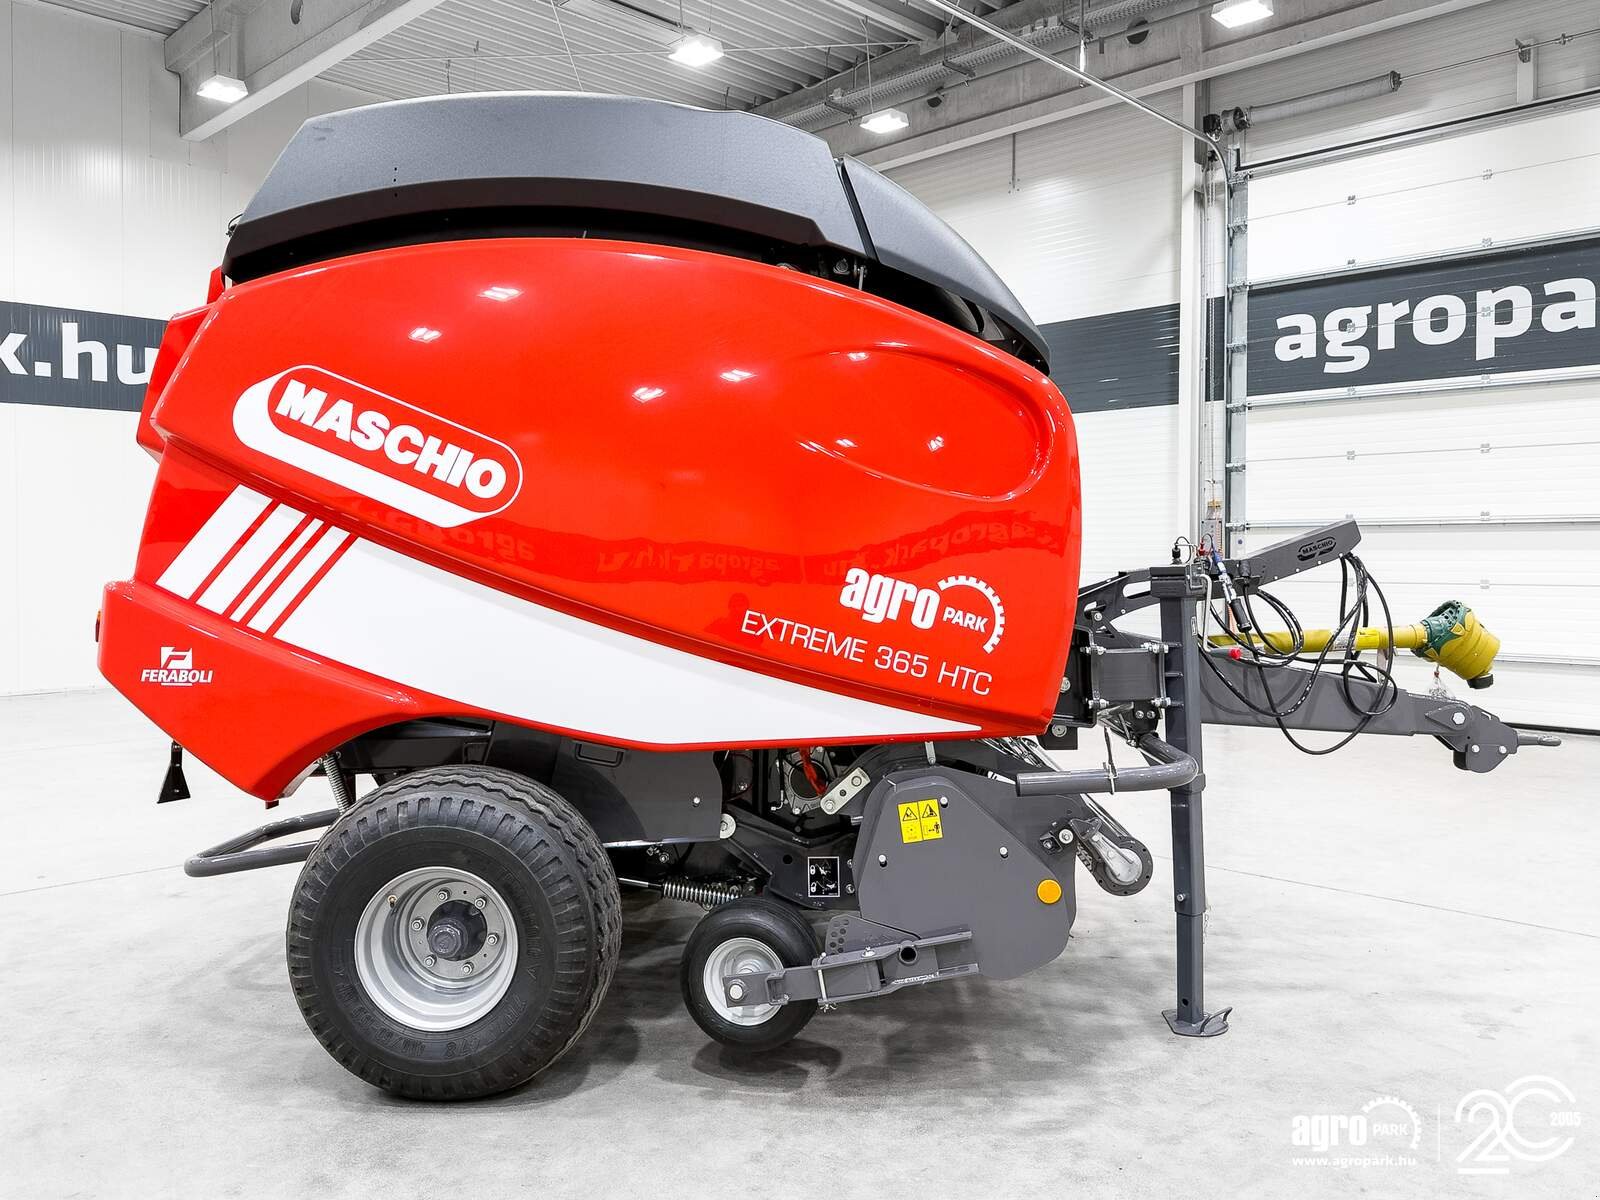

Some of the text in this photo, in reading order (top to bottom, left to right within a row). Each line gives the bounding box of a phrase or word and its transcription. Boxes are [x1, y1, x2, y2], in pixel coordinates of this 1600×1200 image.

[1274, 278, 1597, 374] agropa
[275, 379, 507, 499] MASCHIO
[1302, 540, 1334, 555] MASCHIO
[839, 567, 989, 633] agro PARK
[141, 669, 213, 683] FERABOLI
[741, 610, 993, 696] EXTREME 365 HTC
